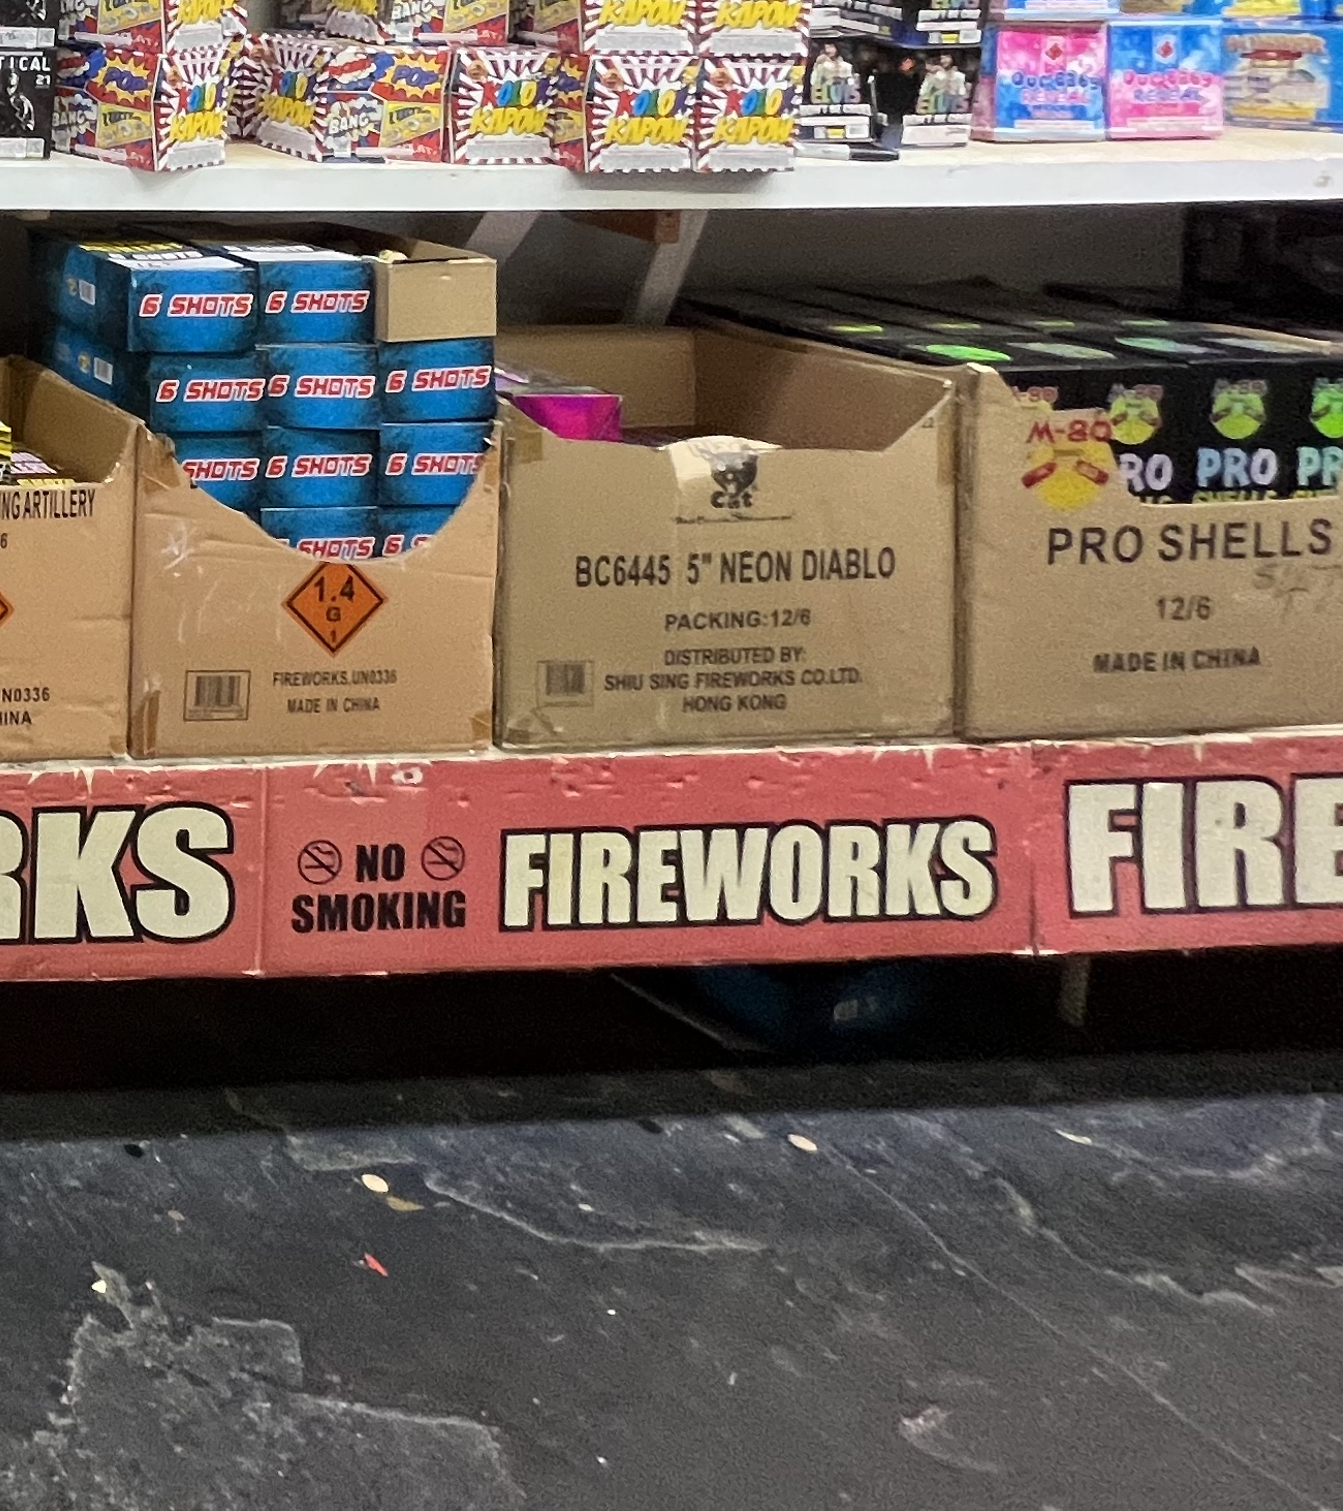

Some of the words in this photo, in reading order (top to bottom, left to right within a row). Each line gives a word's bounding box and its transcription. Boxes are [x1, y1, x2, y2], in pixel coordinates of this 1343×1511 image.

[470, 108, 548, 135] KAPOW
[140, 294, 160, 317] 6
[168, 292, 253, 316] SHOTS
[266, 292, 285, 313] 6
[292, 289, 369, 313] SHOTS
[269, 376, 287, 397] 6
[295, 376, 376, 399] SHOTS
[385, 370, 405, 392] 6
[413, 366, 494, 390] SHOTS
[1026, 421, 1113, 444] M-80
[1197, 447, 1278, 488] PRO
[22, 489, 95, 519] ARTILLERY
[1047, 527, 1144, 565] PRO
[1158, 519, 1332, 562] SHELLS
[575, 555, 671, 587] BC6445
[687, 553, 712, 584] 5"
[721, 550, 791, 583] NEON
[802, 546, 896, 581] DIABLO
[1156, 596, 1211, 620] 12/6
[664, 648, 774, 666] DISTRIBUTED
[1093, 649, 1156, 673] MADE
[1162, 649, 1186, 671] IN
[1194, 646, 1261, 669] CHINA
[604, 674, 643, 690] SHIU
[649, 673, 688, 689] SING
[695, 671, 794, 687] FIREWORKS
[287, 698, 322, 714] MADE
[326, 697, 339, 713] IN
[342, 697, 380, 712] CHINA
[682, 695, 732, 712] HONG
[737, 693, 787, 711] KONG
[356, 843, 405, 882] NO
[498, 816, 998, 932] FIREWORKS
[290, 891, 467, 933] SMOKING
